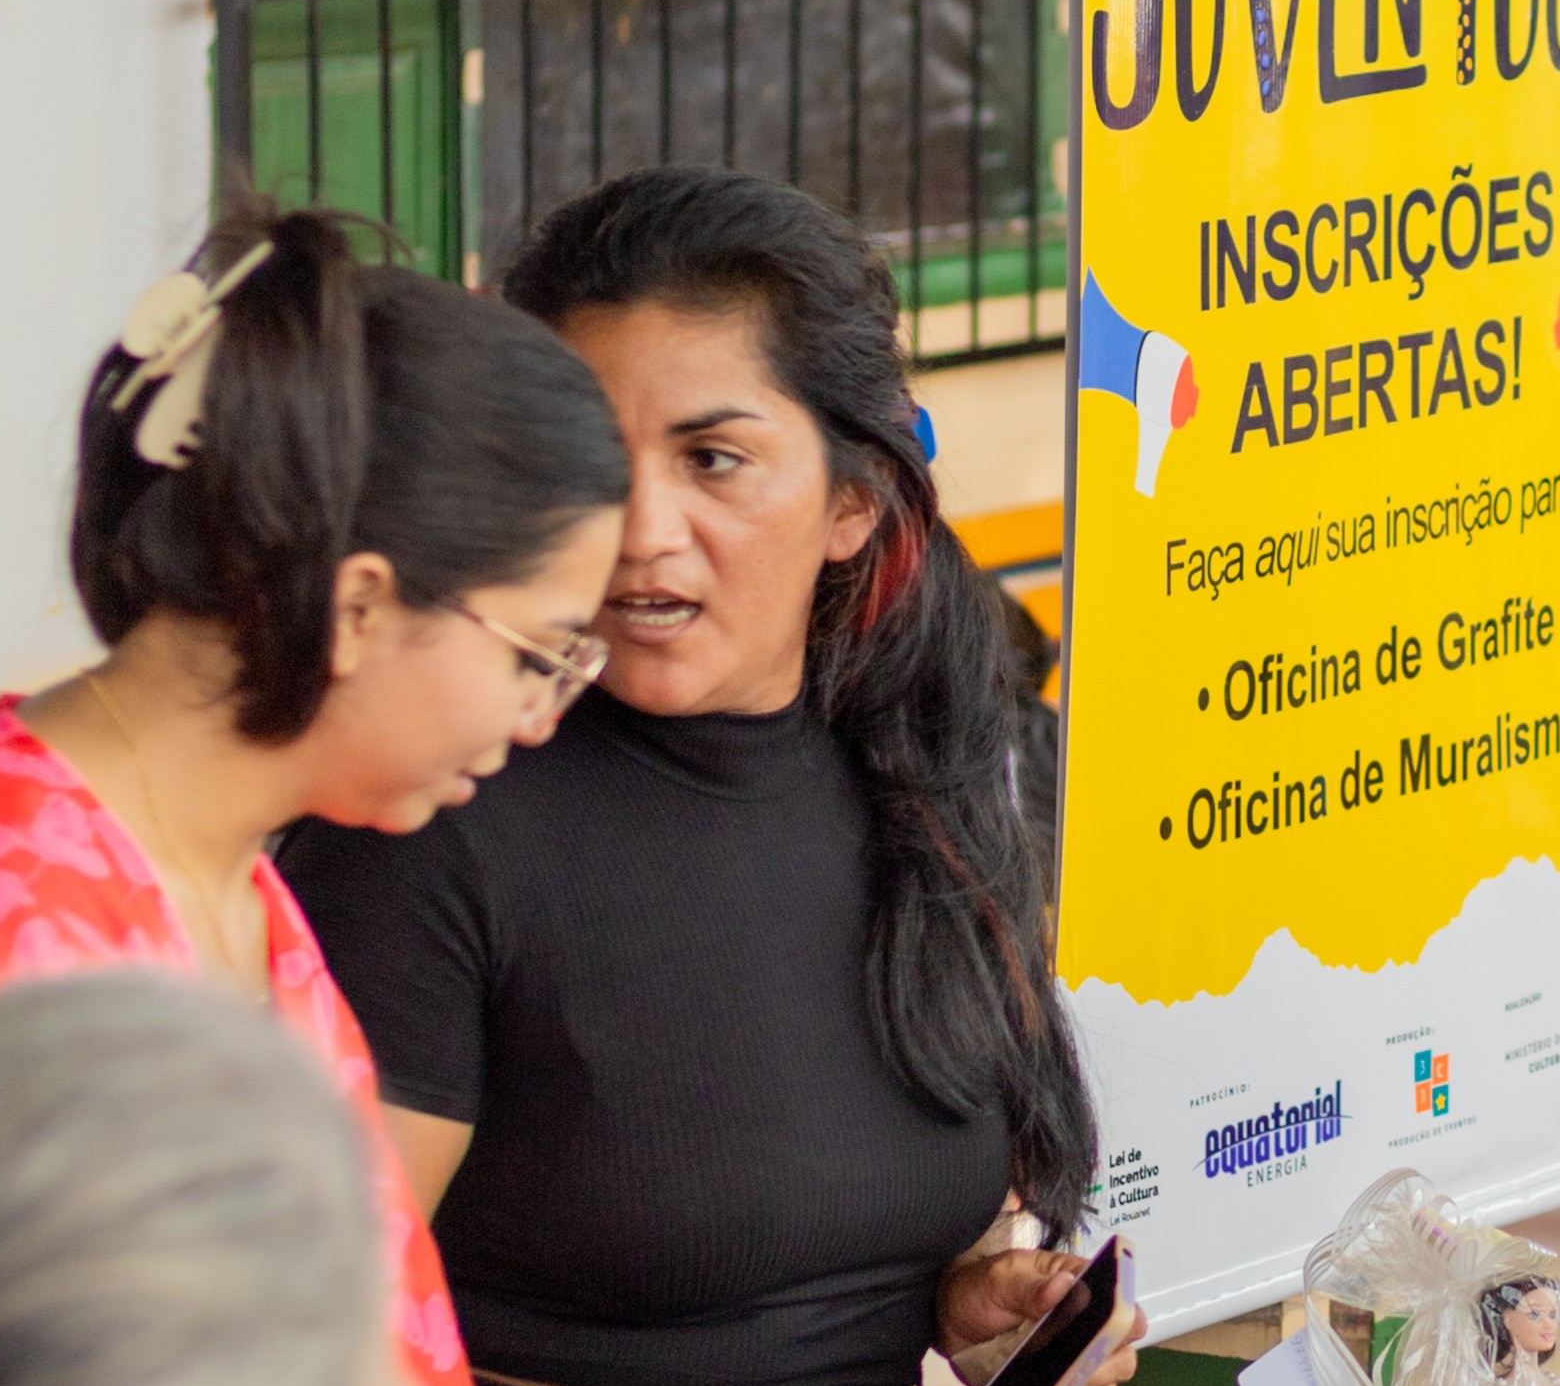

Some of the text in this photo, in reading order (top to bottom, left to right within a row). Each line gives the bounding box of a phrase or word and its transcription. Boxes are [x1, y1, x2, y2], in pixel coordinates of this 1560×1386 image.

[1200, 163, 1554, 311] INSCRIÇÕES
[1230, 316, 1522, 454] ABERTAS!
[1166, 538, 1244, 601] Faça
[1255, 511, 1321, 587] aqui
[1326, 513, 1375, 562] sua
[1386, 477, 1511, 548] inscrição
[1224, 596, 1554, 721] Oficina de Grafite
[1187, 771, 1327, 850] Oficina
[1340, 750, 1384, 810] de
[1505, 1036, 1551, 1061] MINISTÉRIO
[1189, 1083, 1251, 1109] PATROCÍNIO:
[1205, 1079, 1342, 1179] equatorial
[1109, 1148, 1142, 1168] Lei de
[1246, 1154, 1308, 1188] ENERGIA
[1109, 1163, 1159, 1189] Incentivo
[1109, 1184, 1159, 1209] à Cultura
[1110, 1206, 1151, 1227] Lei Rouanet
